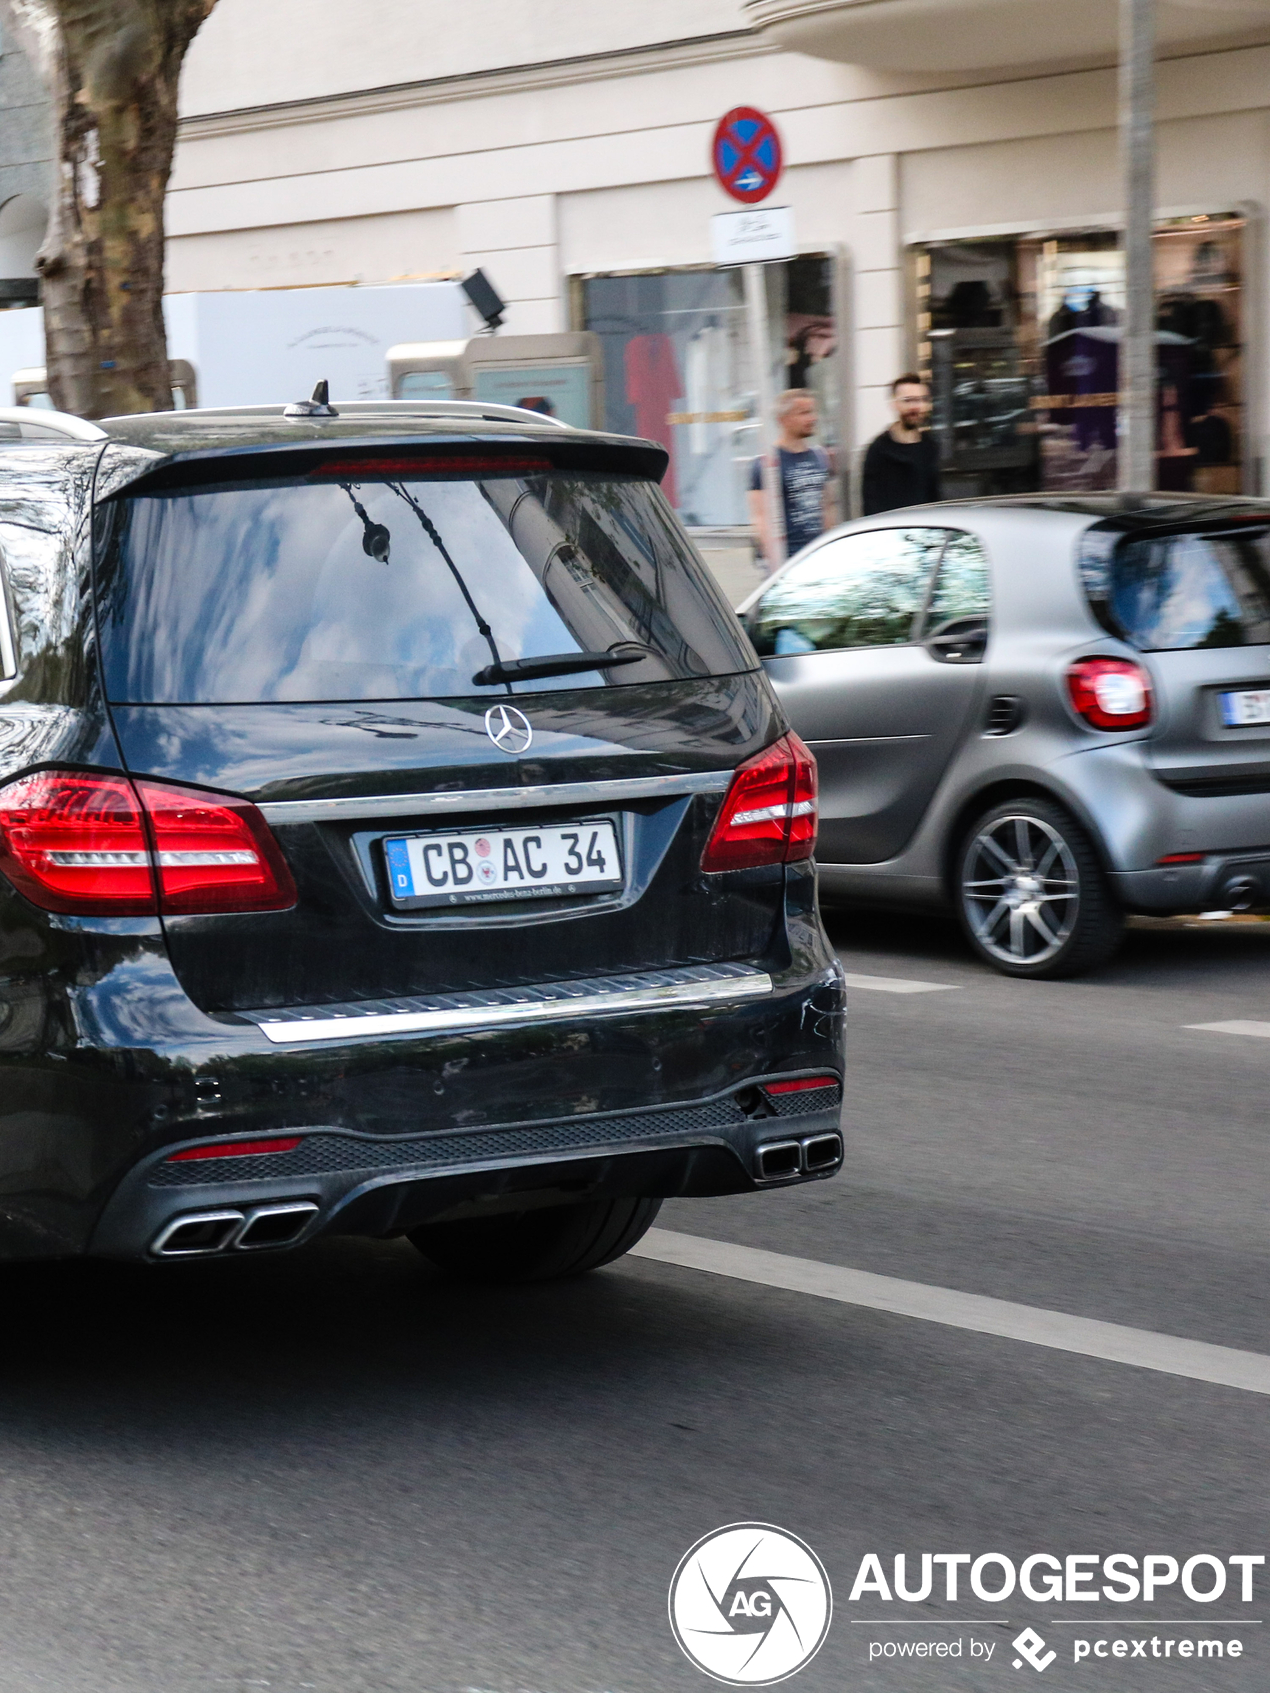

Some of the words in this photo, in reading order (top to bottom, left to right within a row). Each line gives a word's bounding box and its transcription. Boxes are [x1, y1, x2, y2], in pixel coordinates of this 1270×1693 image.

[422, 841, 474, 888] CB
[502, 835, 548, 882] AC
[560, 831, 606, 876] 34
[397, 874, 409, 888] D
